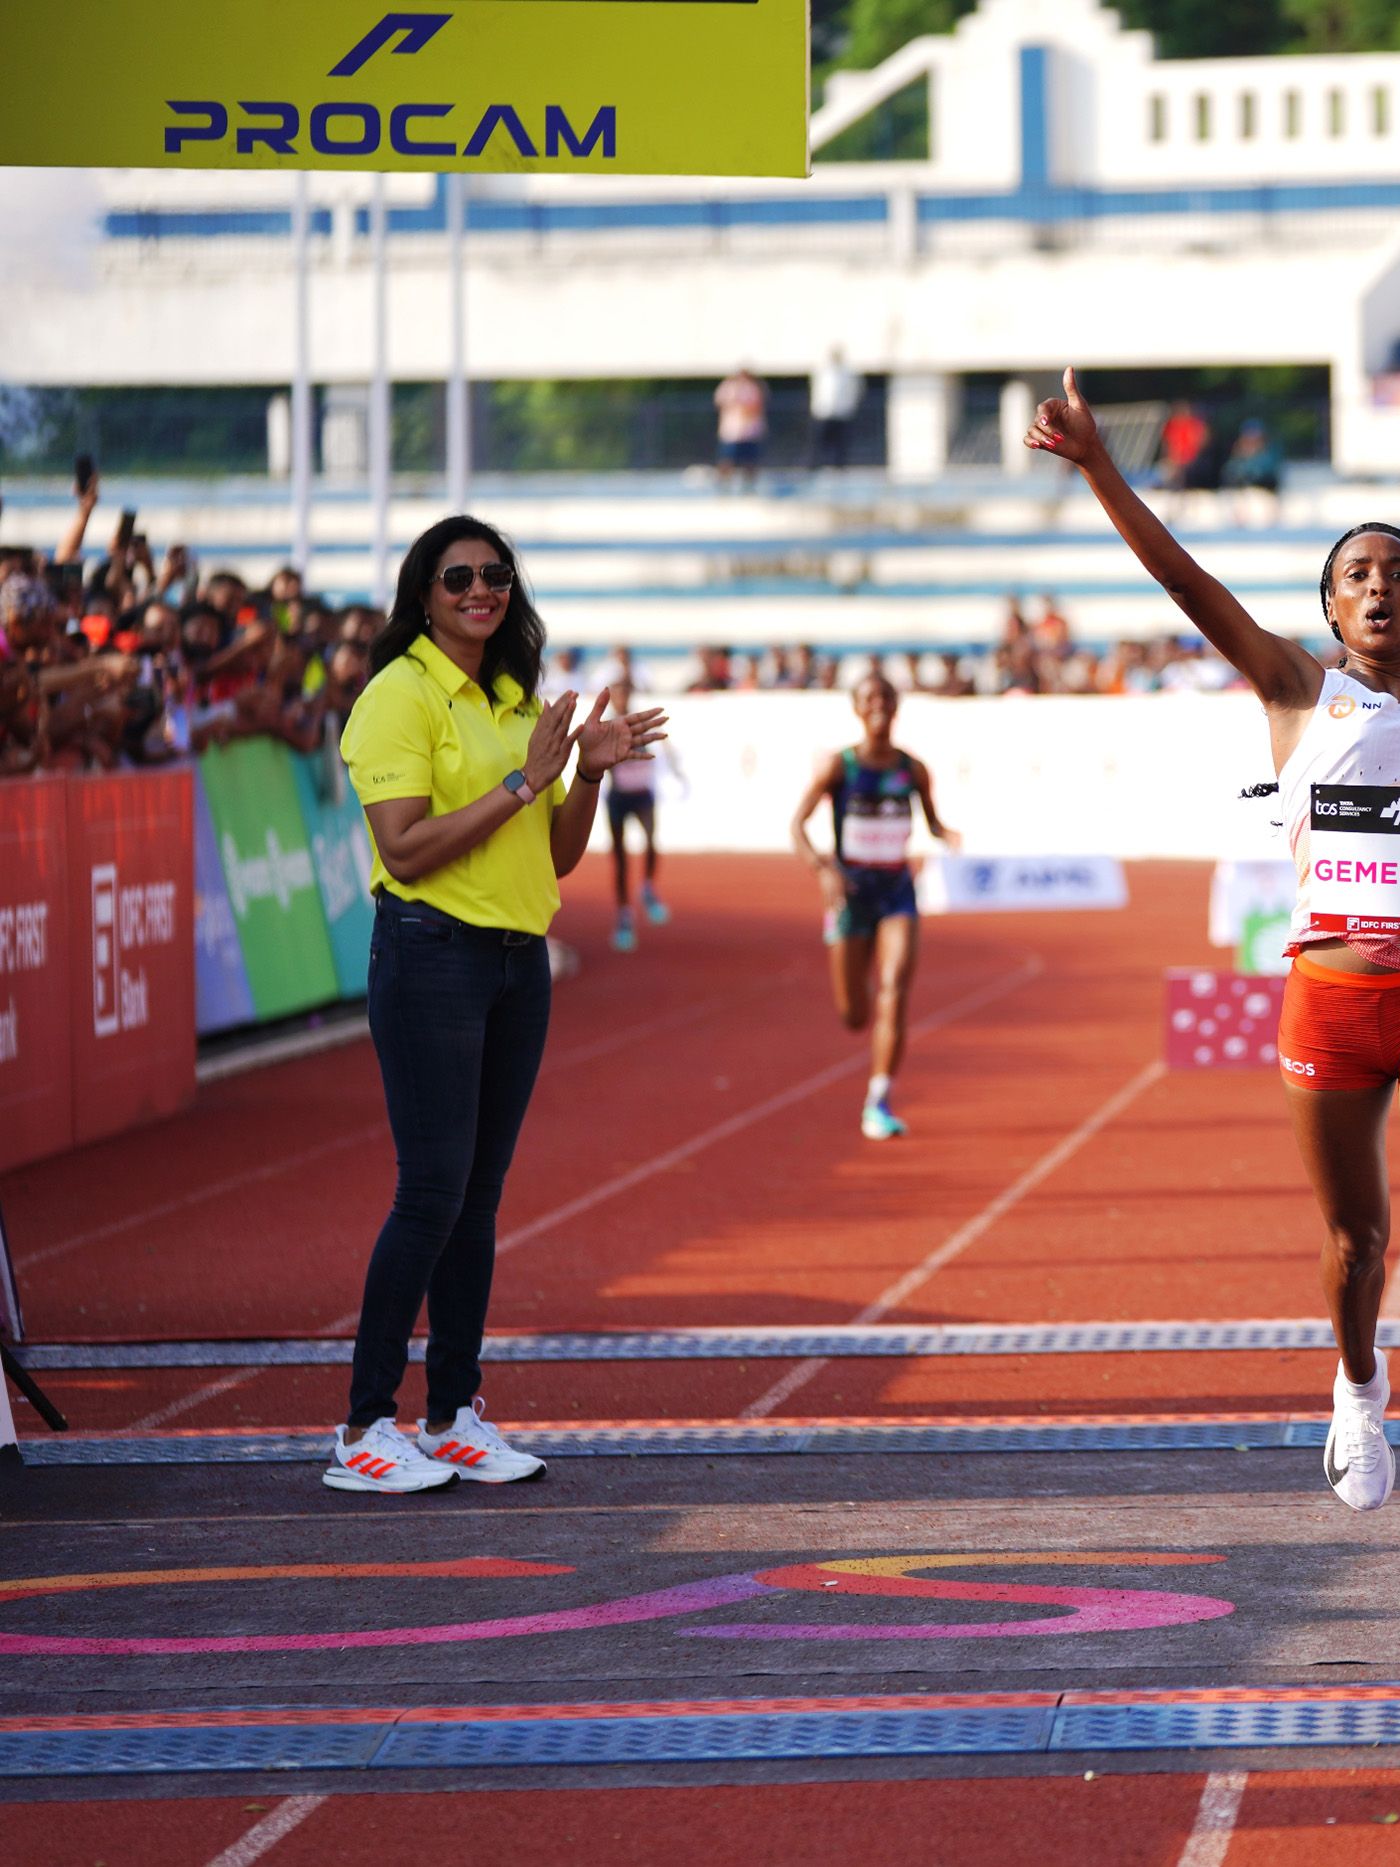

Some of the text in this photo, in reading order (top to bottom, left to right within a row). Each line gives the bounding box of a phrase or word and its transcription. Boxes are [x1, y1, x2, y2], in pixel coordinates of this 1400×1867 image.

[164, 100, 616, 158] PROCAM
[1361, 701, 1382, 710] NN
[1315, 799, 1338, 816] tcs
[1360, 919, 1379, 929] IDFC
